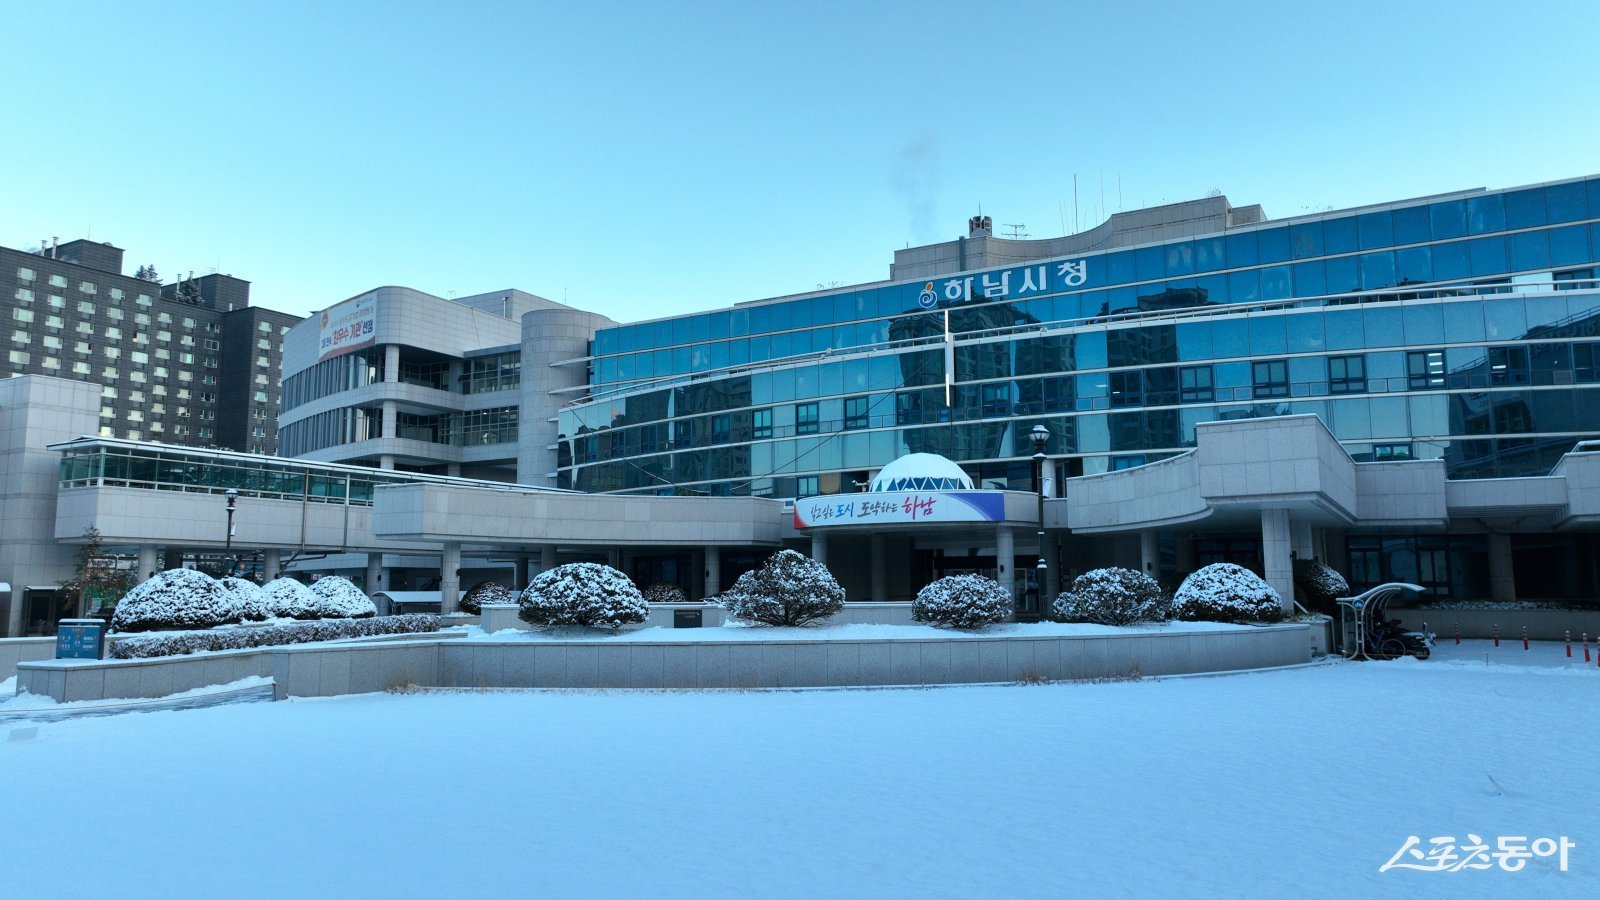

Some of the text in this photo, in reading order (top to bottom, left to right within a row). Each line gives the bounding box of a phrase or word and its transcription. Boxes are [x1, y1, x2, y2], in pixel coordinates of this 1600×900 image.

[943, 260, 1087, 302] 하남시청
[835, 501, 854, 519] 도시
[857, 500, 898, 519] 도약하는
[901, 495, 937, 520] 하남
